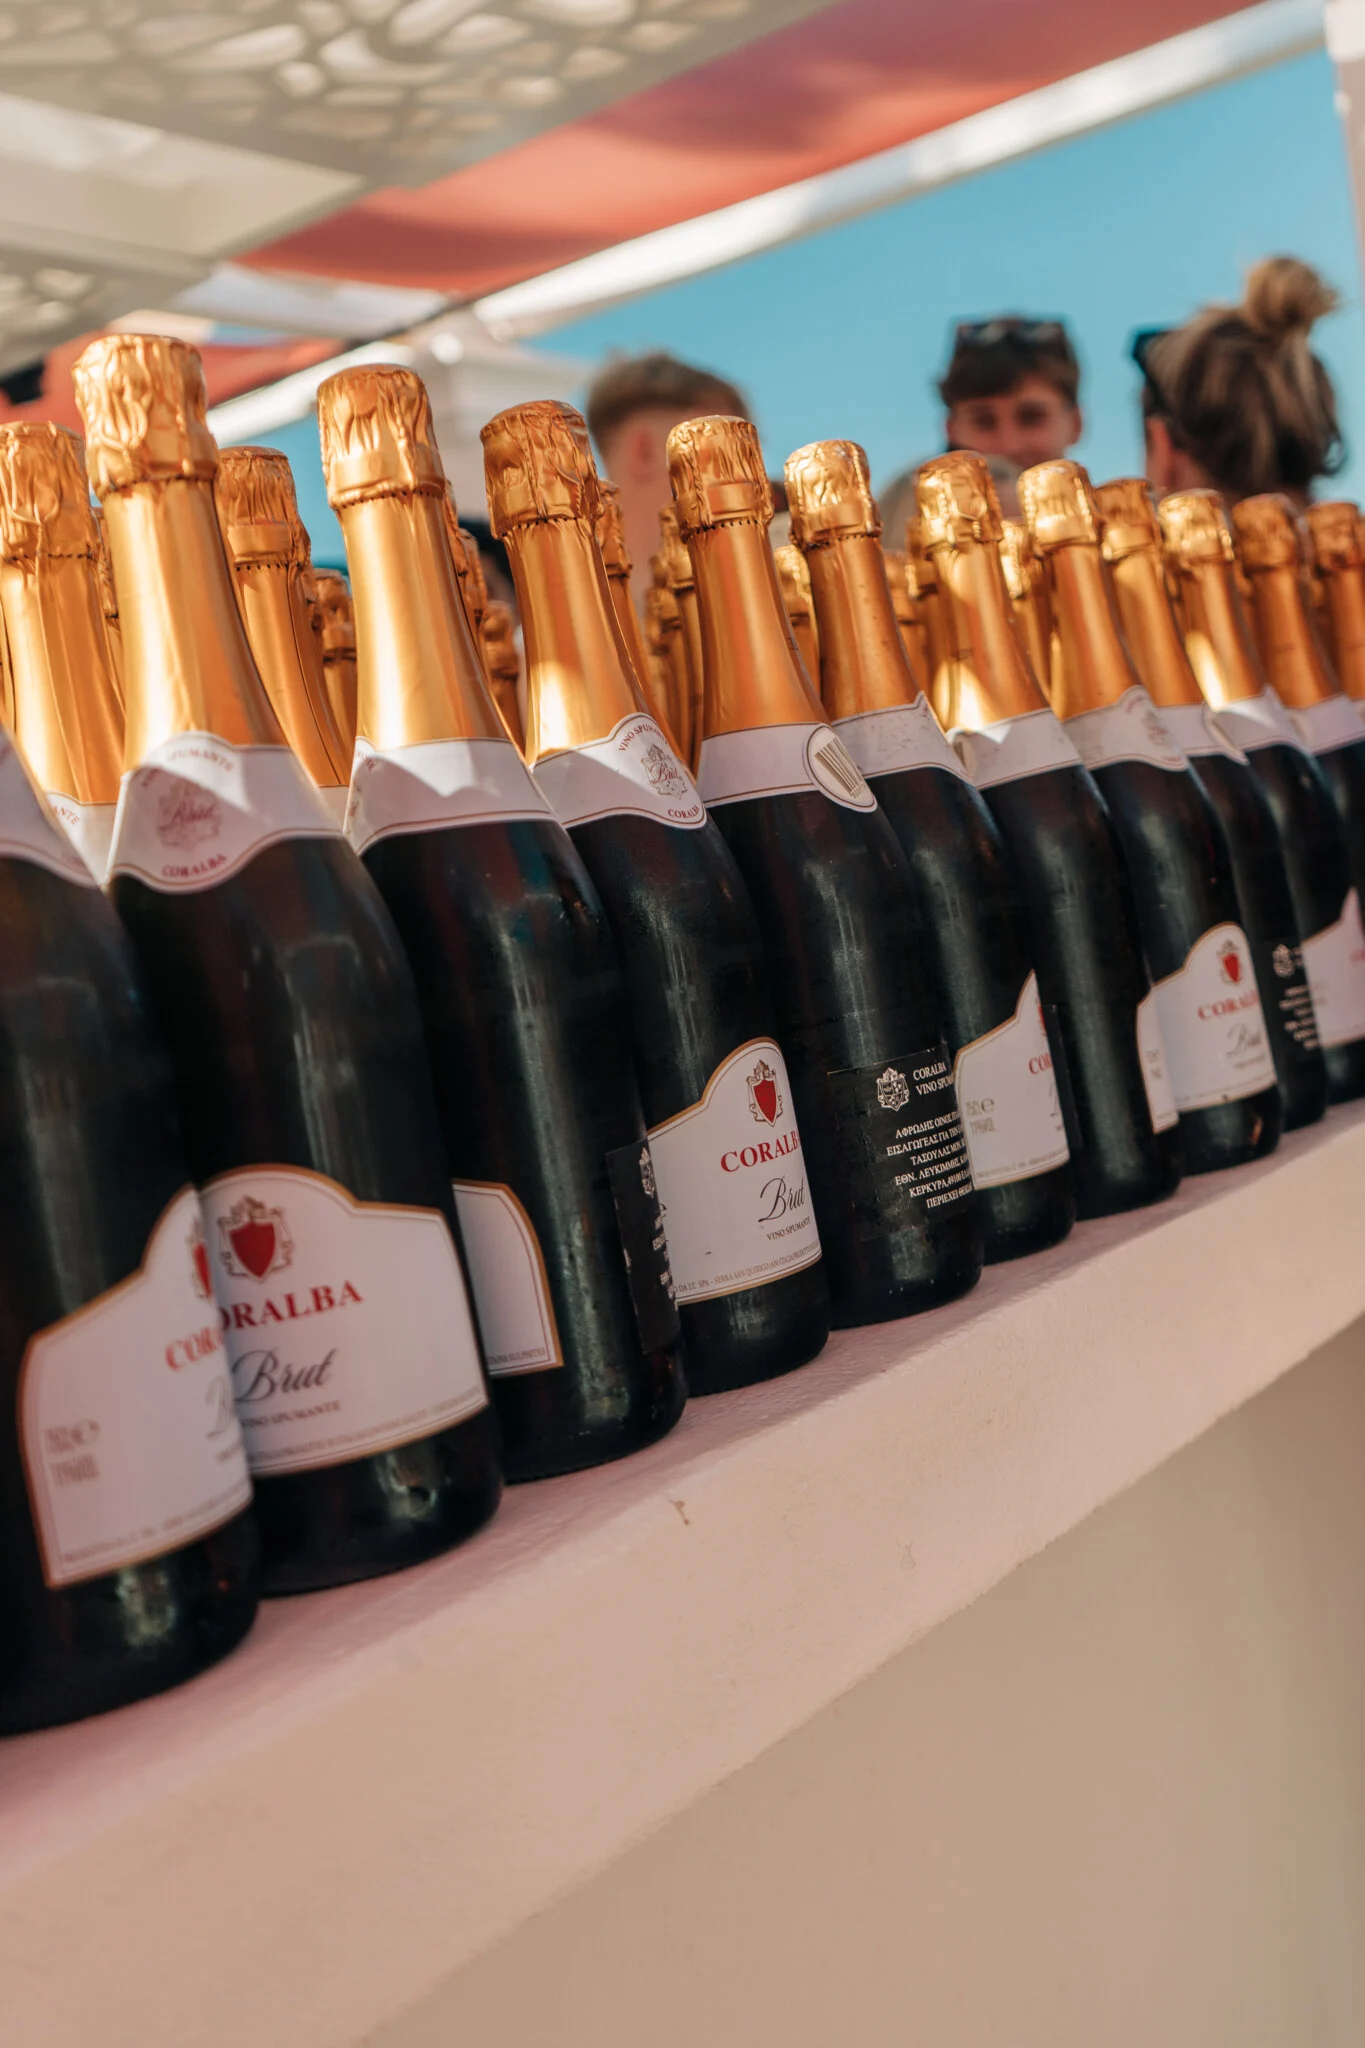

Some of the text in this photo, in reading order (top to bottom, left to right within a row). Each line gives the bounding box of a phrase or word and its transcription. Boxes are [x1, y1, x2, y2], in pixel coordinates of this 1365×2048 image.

[618, 731, 635, 751] VINO
[650, 762, 678, 784] Brut
[915, 1080, 937, 1096] VINO
[758, 1175, 805, 1222] Brut
[767, 1227, 786, 1240] VINO
[231, 1347, 340, 1403] Brut
